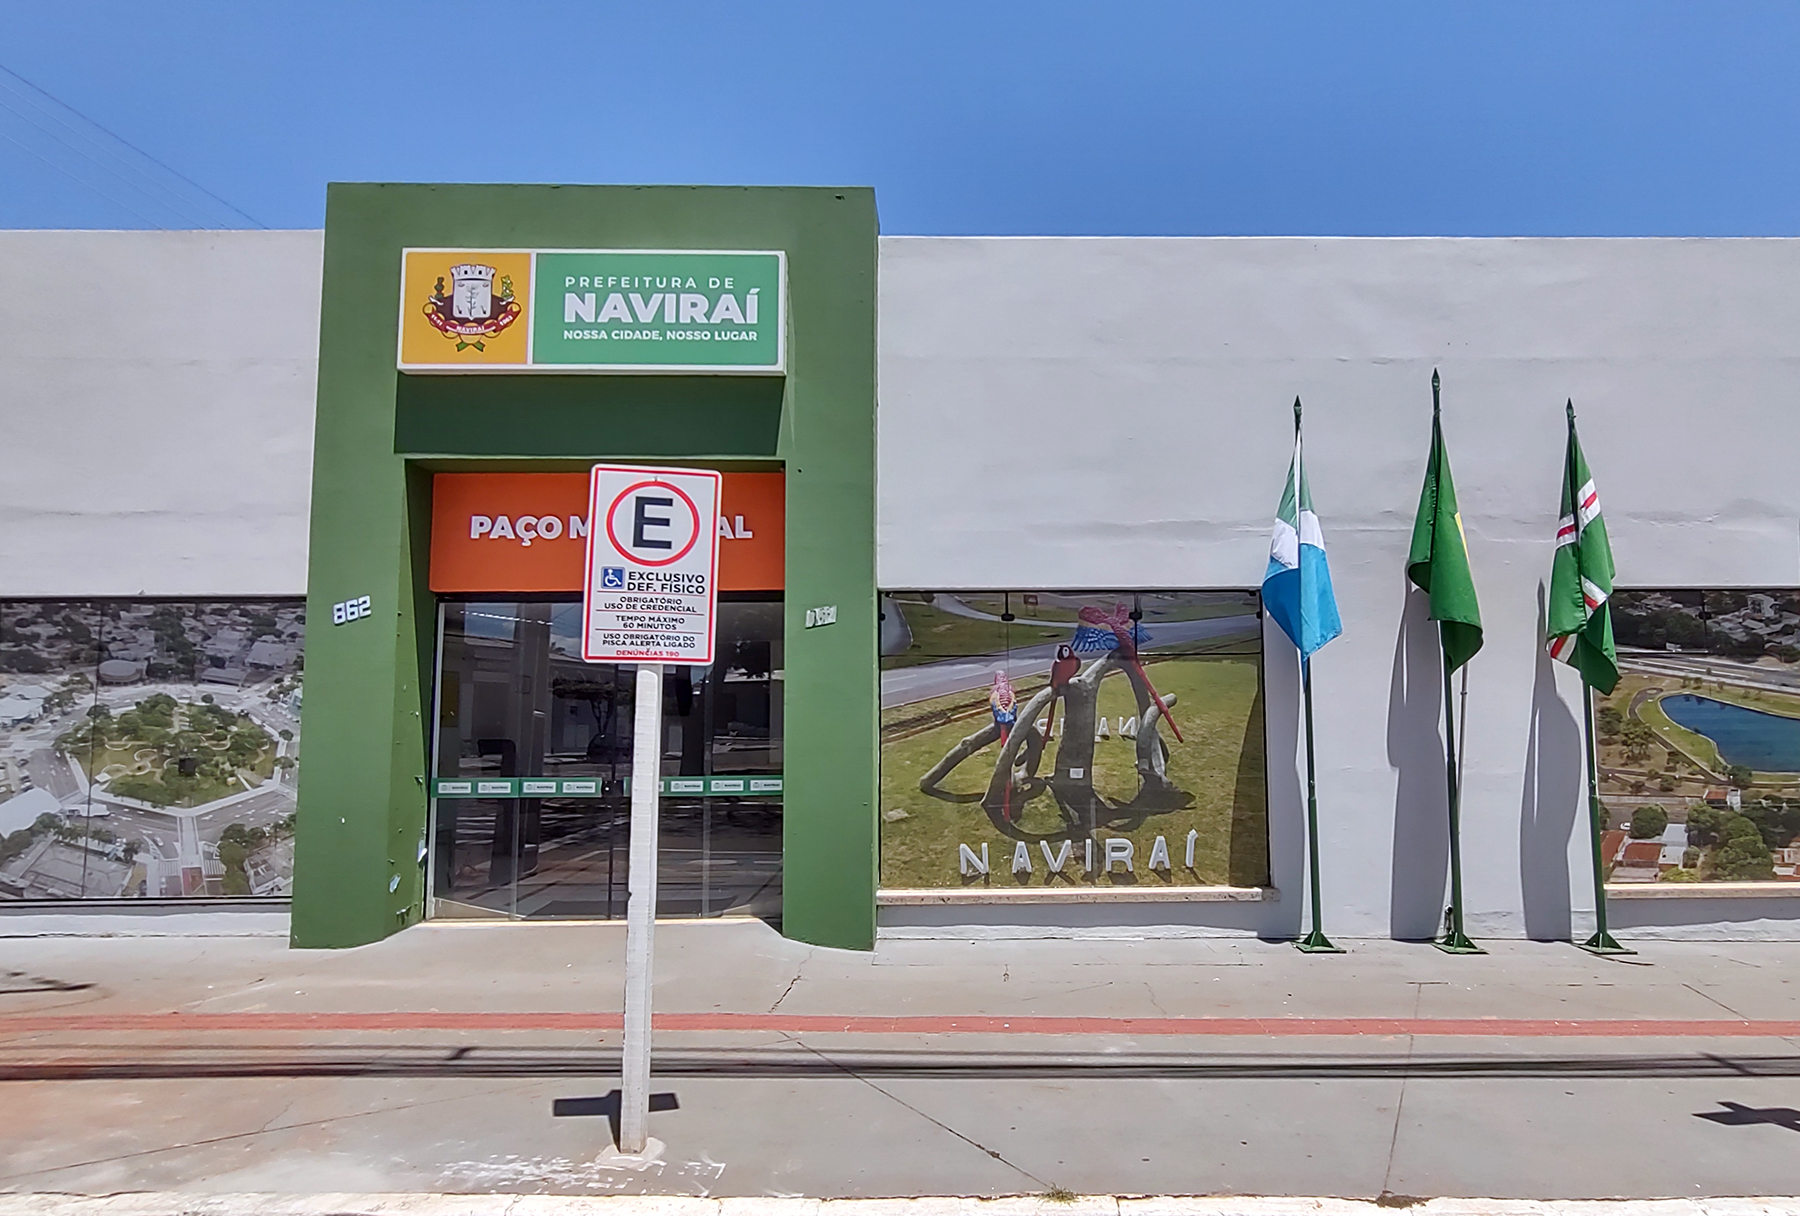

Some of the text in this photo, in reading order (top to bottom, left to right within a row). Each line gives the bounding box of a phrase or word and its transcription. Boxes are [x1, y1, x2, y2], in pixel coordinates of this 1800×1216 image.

[565, 276, 735, 289] PREFEITURA DE
[564, 288, 760, 323] NAVIRAÍ
[563, 329, 758, 342] NOSSA CIDADE, NOSSO LUGAR
[632, 496, 674, 550] E
[469, 515, 562, 546] PAÇO
[628, 571, 705, 583] EXCLUSIVO
[627, 582, 706, 594] DEF. FÍSICO
[619, 596, 683, 605] OBRIGATÓRIO
[332, 595, 372, 624] 862
[626, 603, 639, 611] DE
[640, 604, 697, 613] CREDENCIAL
[616, 615, 685, 624] TEMPO MÁXIMO
[623, 633, 681, 642] OBRIGATÓRIO
[628, 640, 662, 648] ALERTA
[663, 641, 696, 649] LIGADO
[616, 648, 680, 658] DENÚNCIAS 190
[958, 828, 1199, 876] NAVIRAÍ
